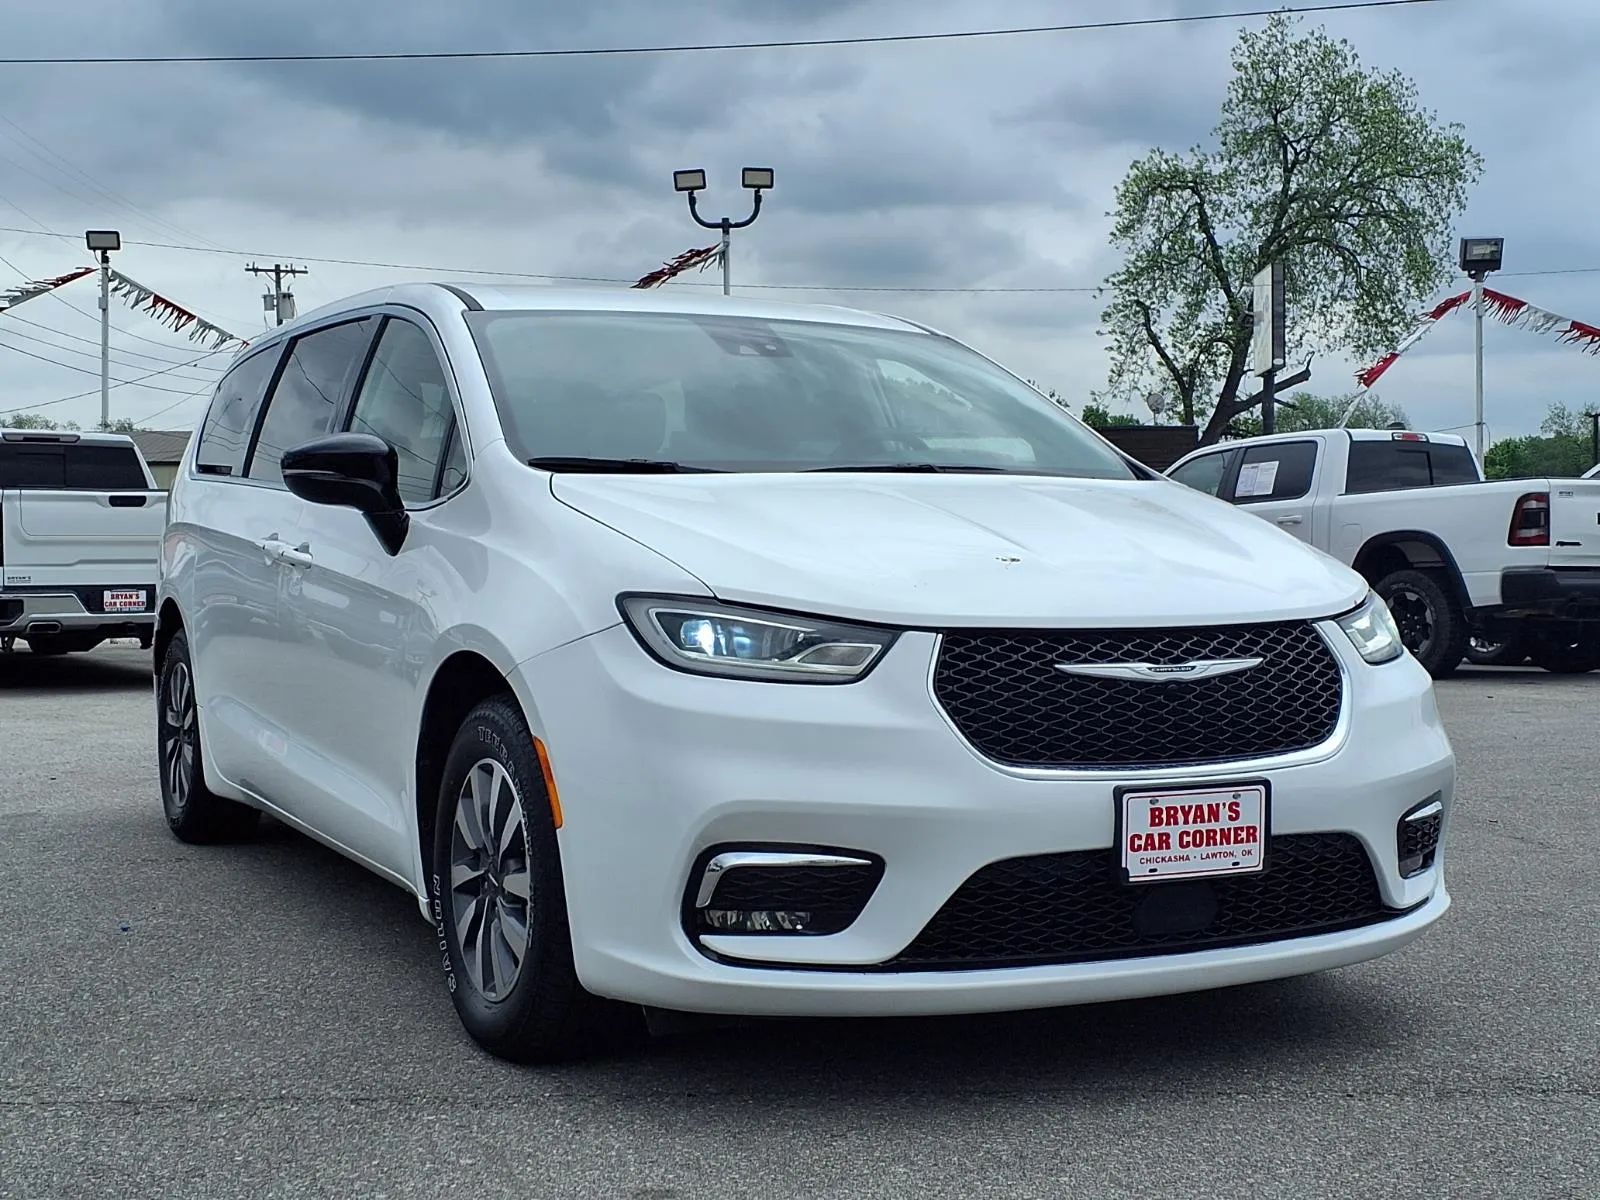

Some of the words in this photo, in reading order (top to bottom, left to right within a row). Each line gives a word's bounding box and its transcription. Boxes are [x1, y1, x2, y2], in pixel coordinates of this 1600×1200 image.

[1149, 801, 1241, 828] BRYAN'S
[1129, 832, 1172, 852] CAR
[1178, 825, 1258, 849] CORNER
[1139, 854, 1190, 865] CHICKASHA
[1200, 851, 1237, 860] LAWTON,
